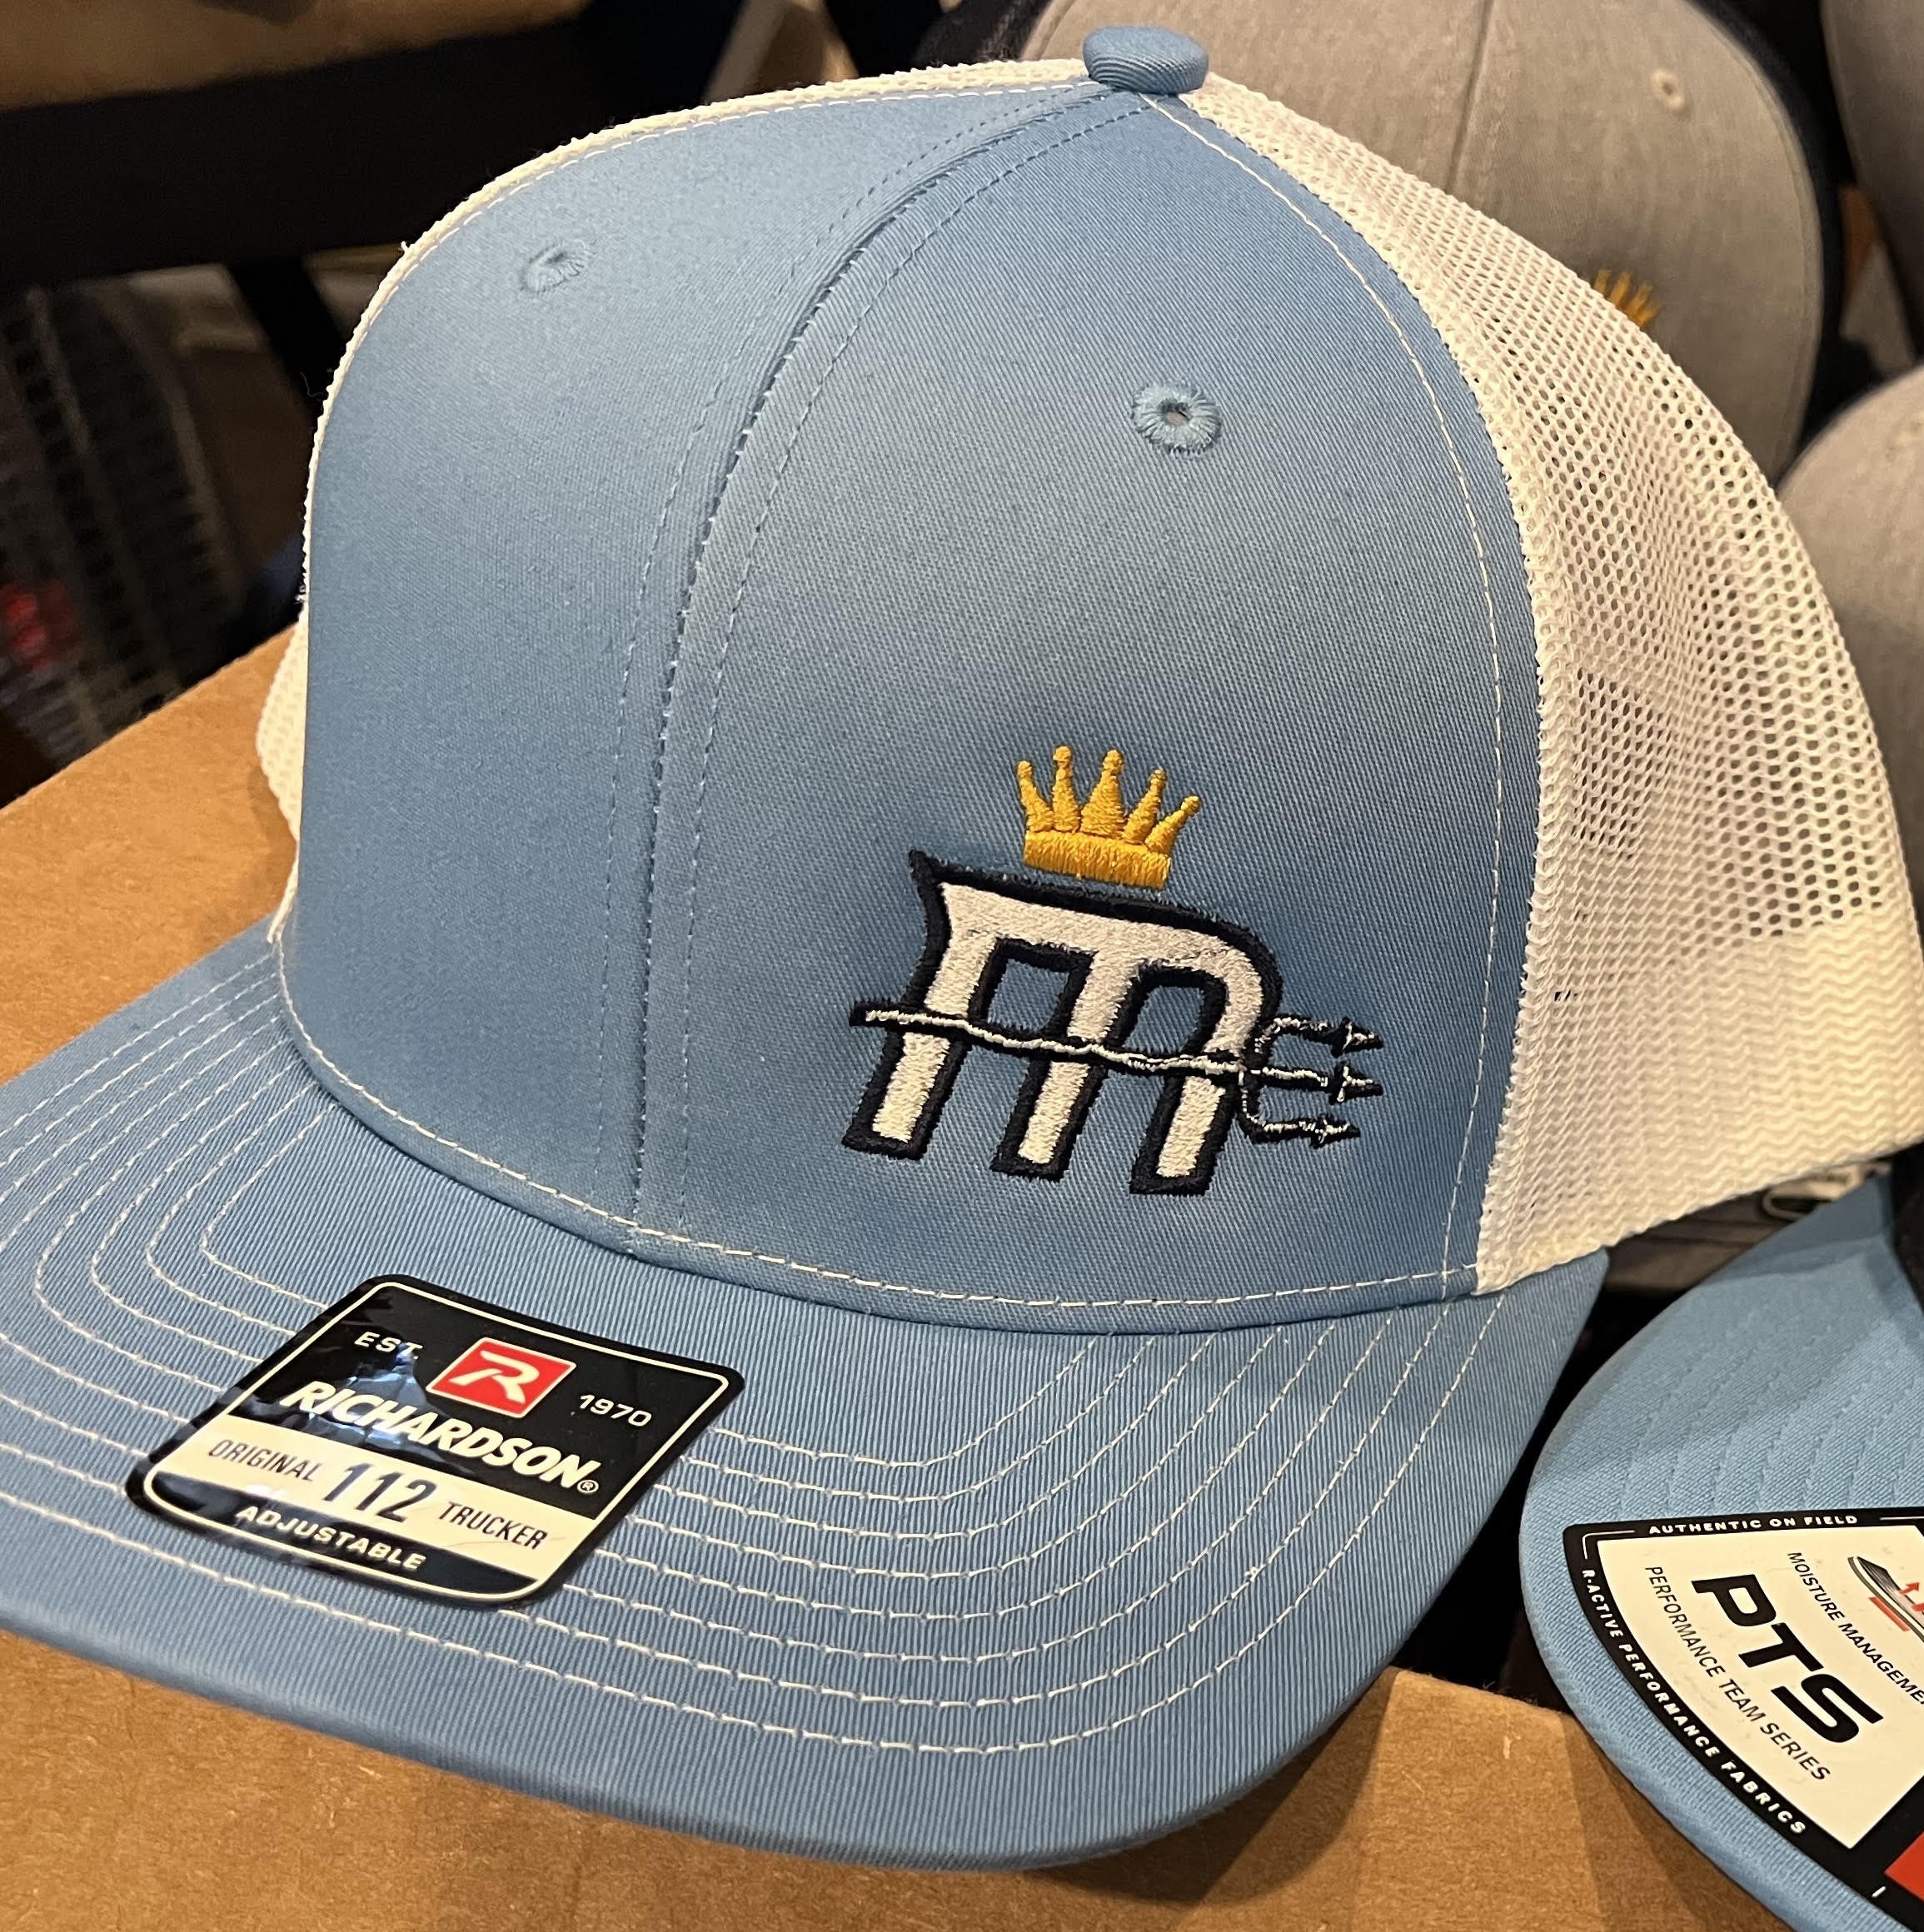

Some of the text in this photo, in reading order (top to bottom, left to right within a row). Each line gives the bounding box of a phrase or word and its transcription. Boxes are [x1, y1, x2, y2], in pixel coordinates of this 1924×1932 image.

[450, 1350, 541, 1404] R
[578, 1393, 652, 1427] 1970
[208, 1439, 550, 1551] ORIGINAL 112 TRUCKER
[1648, 1515, 1858, 1535] AUTHENTIC ON FIELD
[235, 1505, 426, 1570] ADJUSTABLE
[1787, 1551, 1845, 1621] MOISTURE
[1644, 1565, 1831, 1781] PERFORMANCE TEAM SERIES
[1691, 1574, 1884, 1744] PTS
[1581, 1569, 1807, 1834] R-ACTIVE PERFORMANCE FABRICS
